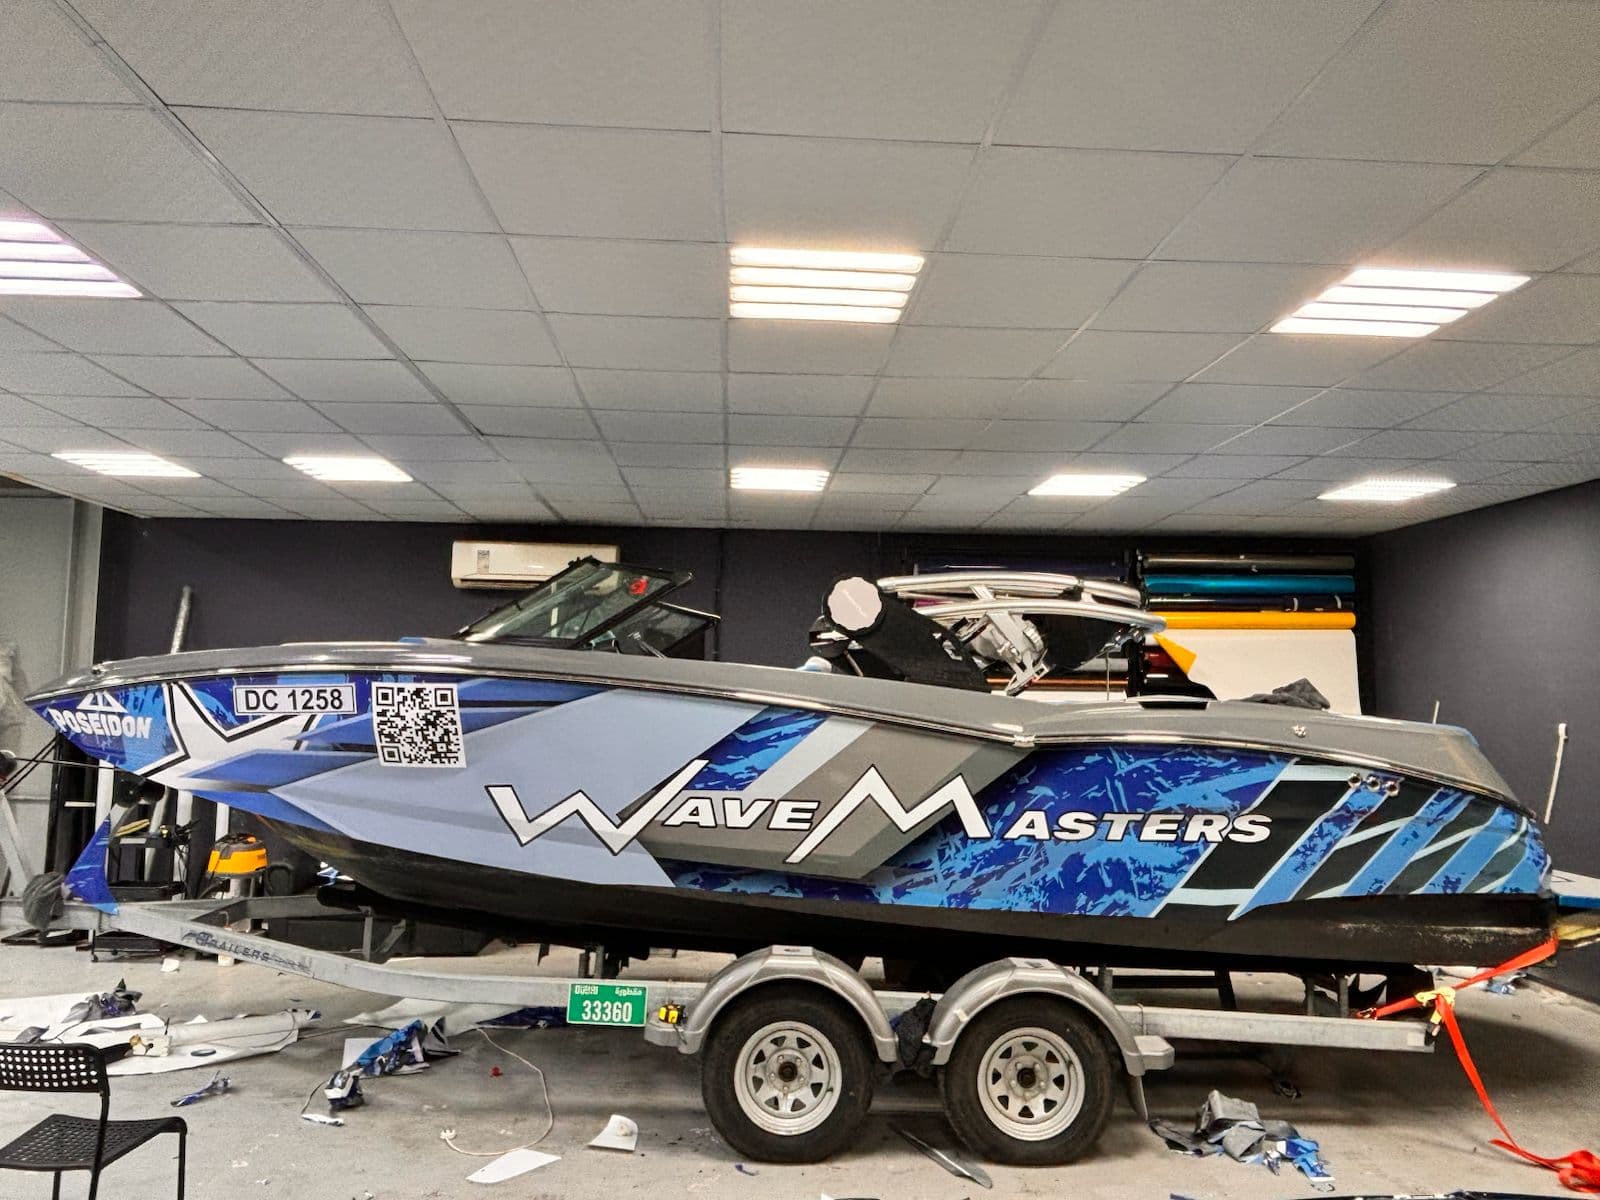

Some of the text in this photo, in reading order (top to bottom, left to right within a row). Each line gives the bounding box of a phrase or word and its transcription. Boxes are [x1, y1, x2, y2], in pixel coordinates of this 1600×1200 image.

[244, 688, 344, 711] DC 1258
[47, 707, 153, 739] POSEIDON
[581, 1000, 633, 1023] 33360
